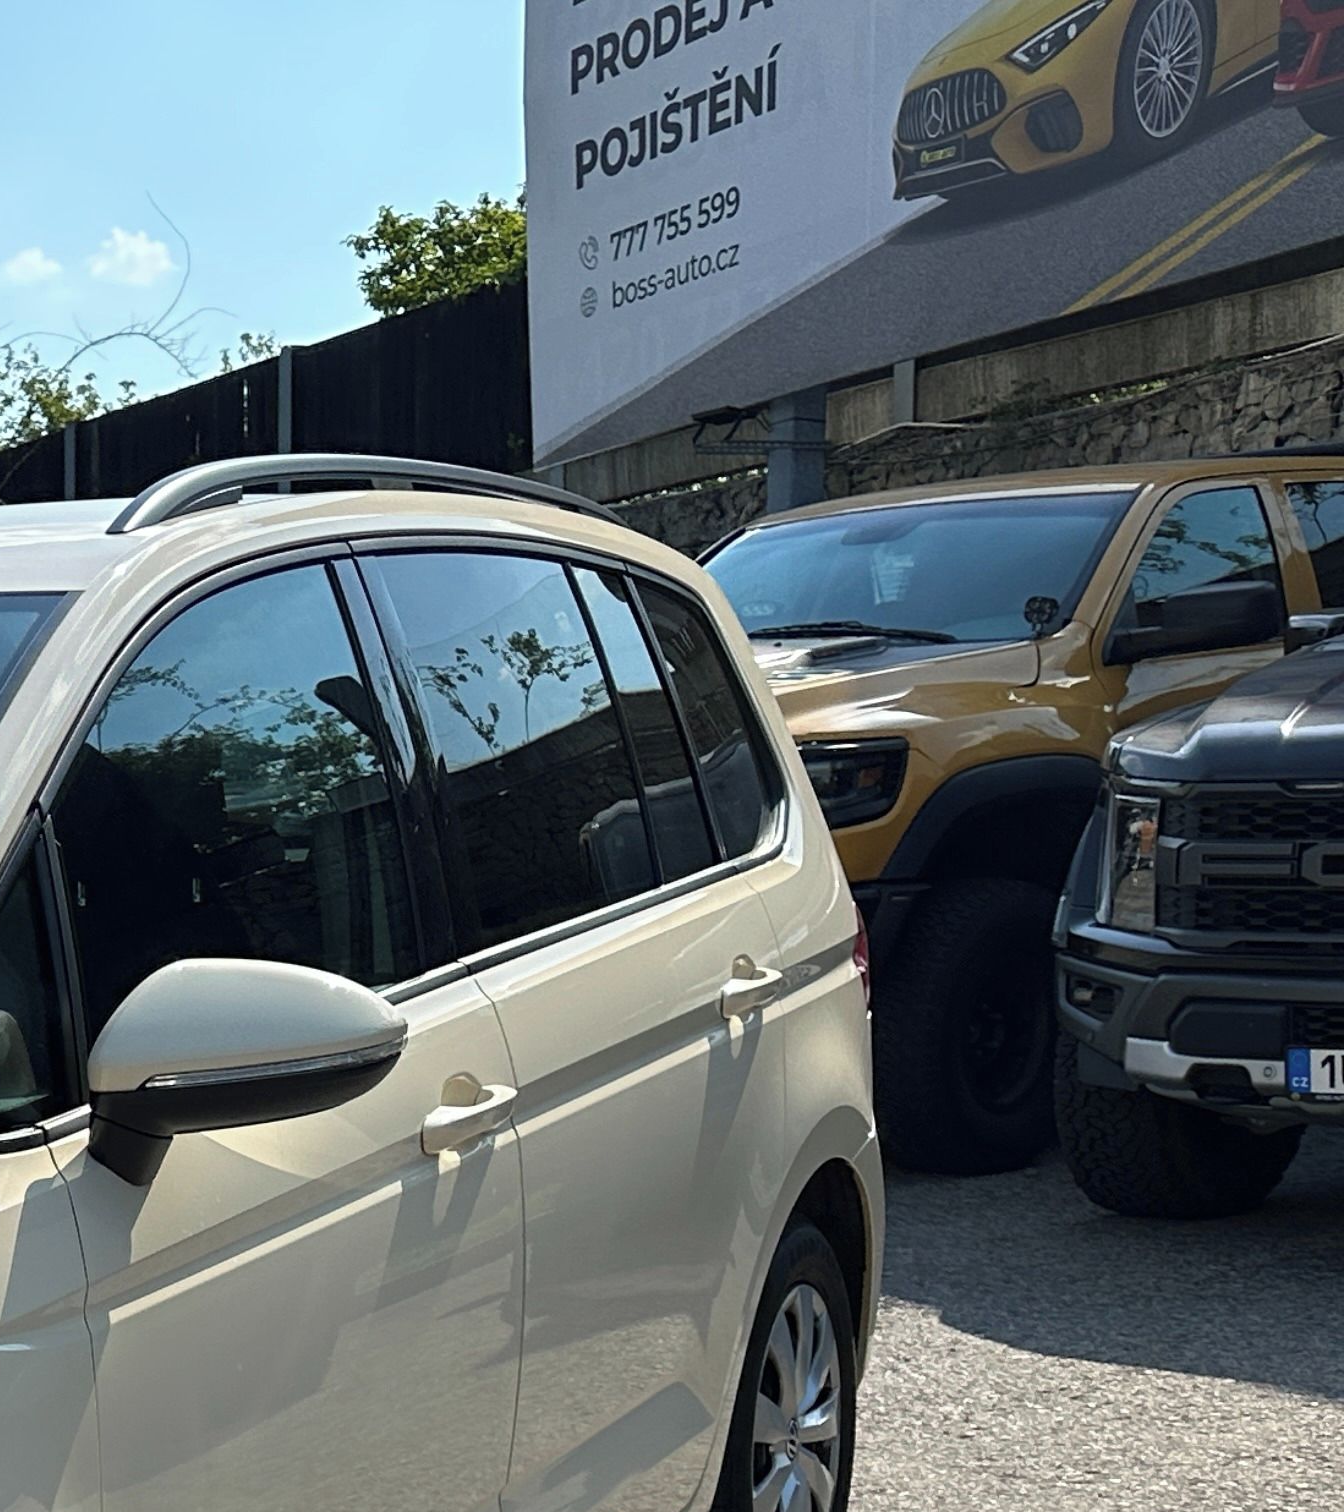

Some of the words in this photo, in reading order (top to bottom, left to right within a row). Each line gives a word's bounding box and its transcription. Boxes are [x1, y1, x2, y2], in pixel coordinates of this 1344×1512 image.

[571, 0, 728, 95] PRODEJ
[576, 42, 782, 190] POJIŠTĚNÍ
[610, 220, 648, 261] 777
[654, 203, 692, 245] 755
[697, 186, 740, 228] 599
[613, 244, 740, 308] boss-auto.cz
[1292, 1076, 1309, 1088] CZ
